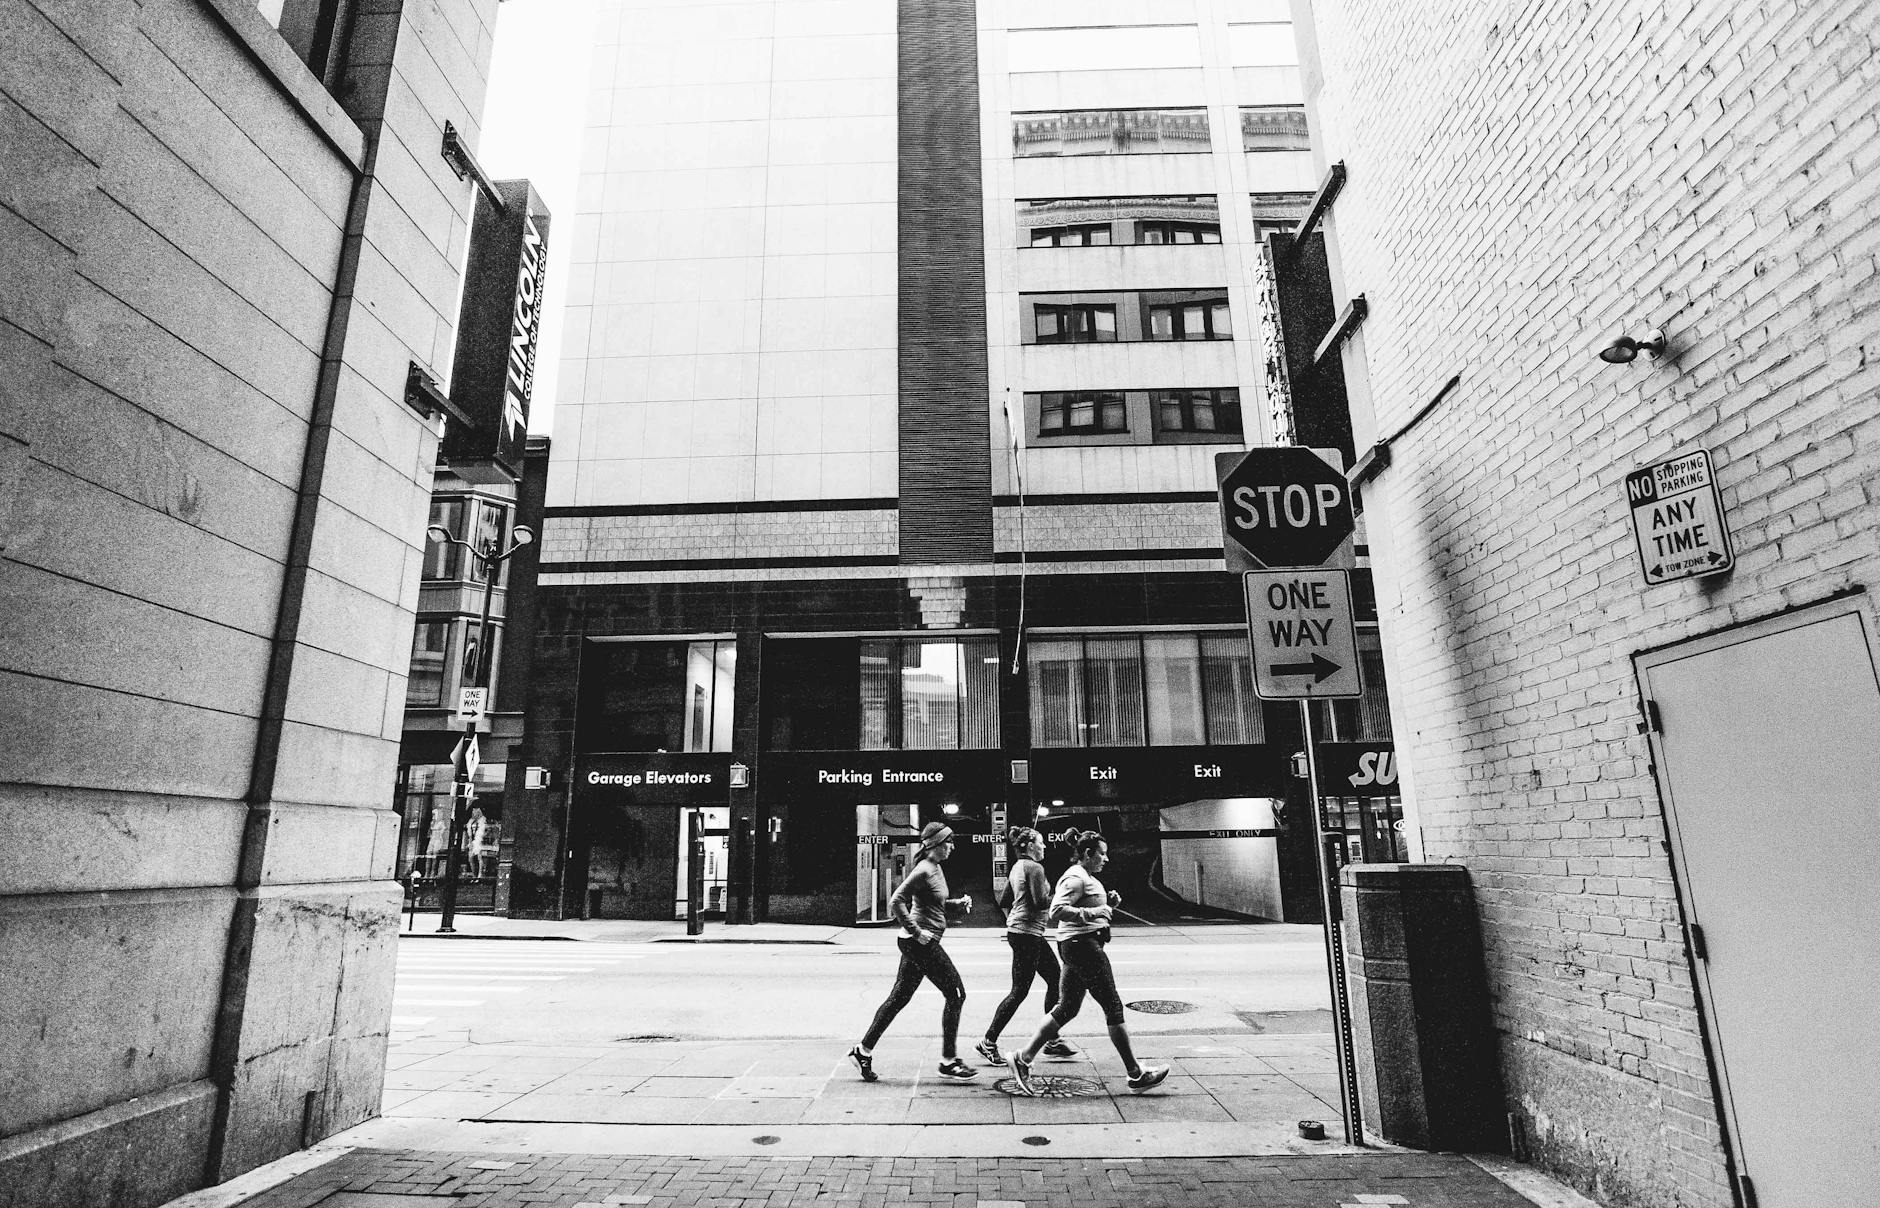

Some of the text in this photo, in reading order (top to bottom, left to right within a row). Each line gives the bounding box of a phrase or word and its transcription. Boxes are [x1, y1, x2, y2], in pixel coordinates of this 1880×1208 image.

[509, 215, 542, 394] LINCOLN
[524, 241, 547, 400] COLLEGE OF TECHNOLOGY
[1656, 456, 1704, 481] STOPPING
[1628, 475, 1653, 501] NO
[1661, 470, 1704, 493] PARKING
[1233, 483, 1341, 530] STOP
[1652, 496, 1696, 530] ANY
[1652, 523, 1708, 557] TIME
[1665, 562, 1682, 573] TOW
[1683, 556, 1706, 569] ZONE
[1267, 582, 1331, 611] ONE
[1268, 618, 1333, 648] WAY
[464, 699, 480, 707] WAY
[465, 690, 480, 698] ONE
[588, 771, 712, 787] Garage Elevators
[818, 769, 944, 786] Parking Entrance
[1090, 766, 1118, 780] Exit
[1194, 764, 1222, 778] Exit
[1348, 751, 1399, 788] SU
[858, 835, 889, 844] ENTER
[972, 834, 1002, 843] ENTER
[1048, 832, 1066, 842] EXI
[1209, 829, 1261, 838] EXIT ONLY
